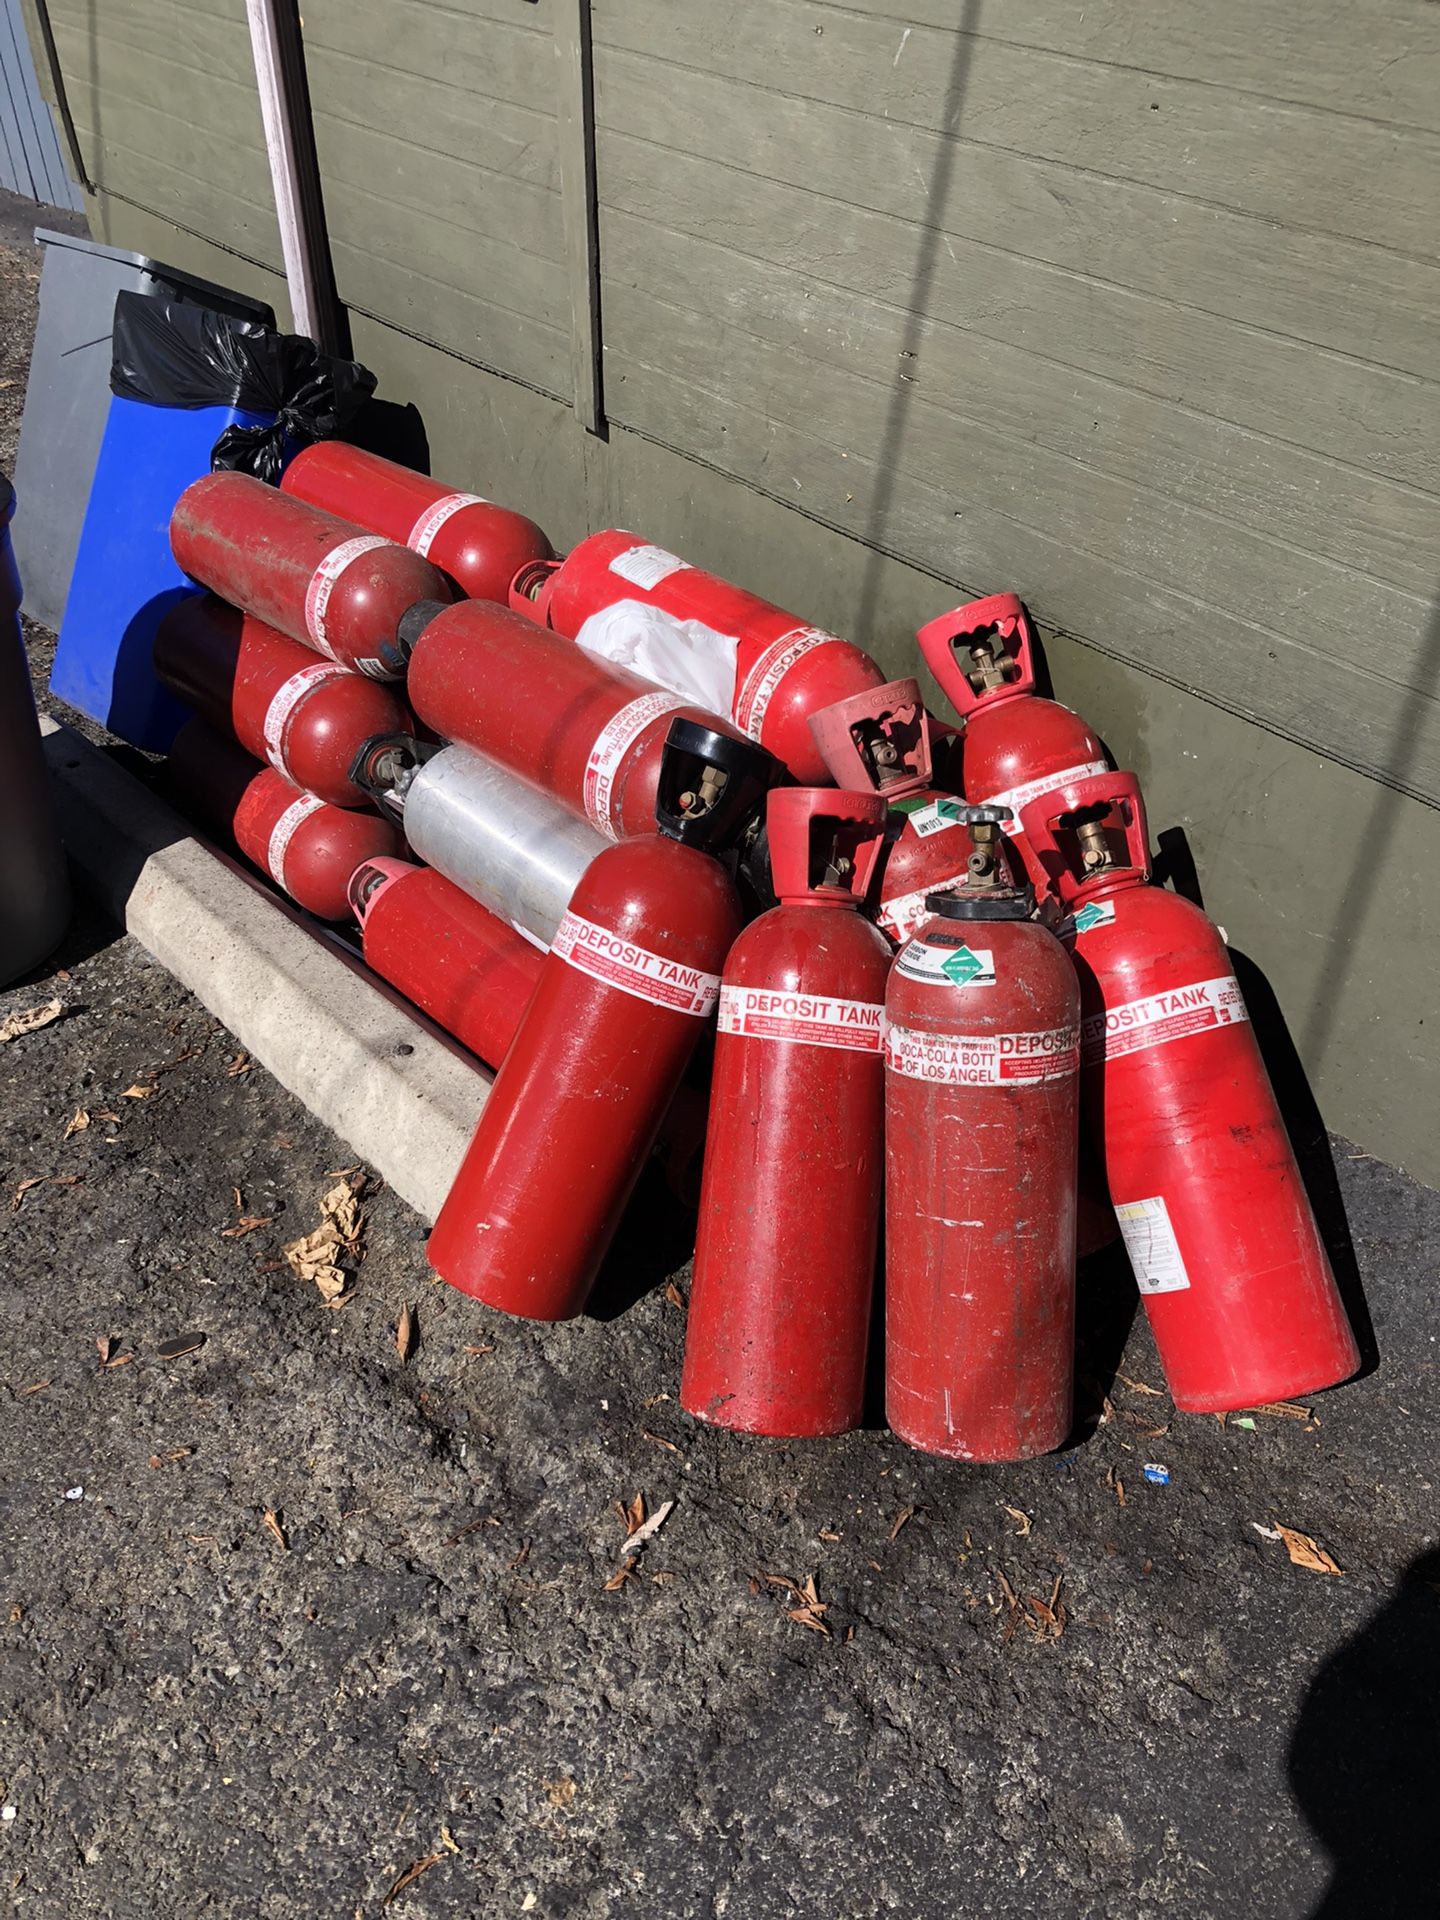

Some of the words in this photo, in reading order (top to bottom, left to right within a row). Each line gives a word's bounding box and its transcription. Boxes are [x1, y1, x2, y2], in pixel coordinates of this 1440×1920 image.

[766, 637, 820, 690] DEPOSIT
[604, 709, 634, 737] ANGELES
[601, 726, 629, 766] BOTTLING
[917, 817, 943, 834] UN1013
[578, 924, 654, 970] DEPOSIT
[657, 960, 703, 989] TANK
[746, 993, 831, 1019] DEPOSIT
[837, 1004, 882, 1027] TANK
[1155, 986, 1210, 1014] TANK
[905, 1060, 919, 1073] OF
[922, 1064, 946, 1079] LOS
[947, 1066, 995, 1083] ANGEL
[962, 1051, 996, 1067] BOTT
